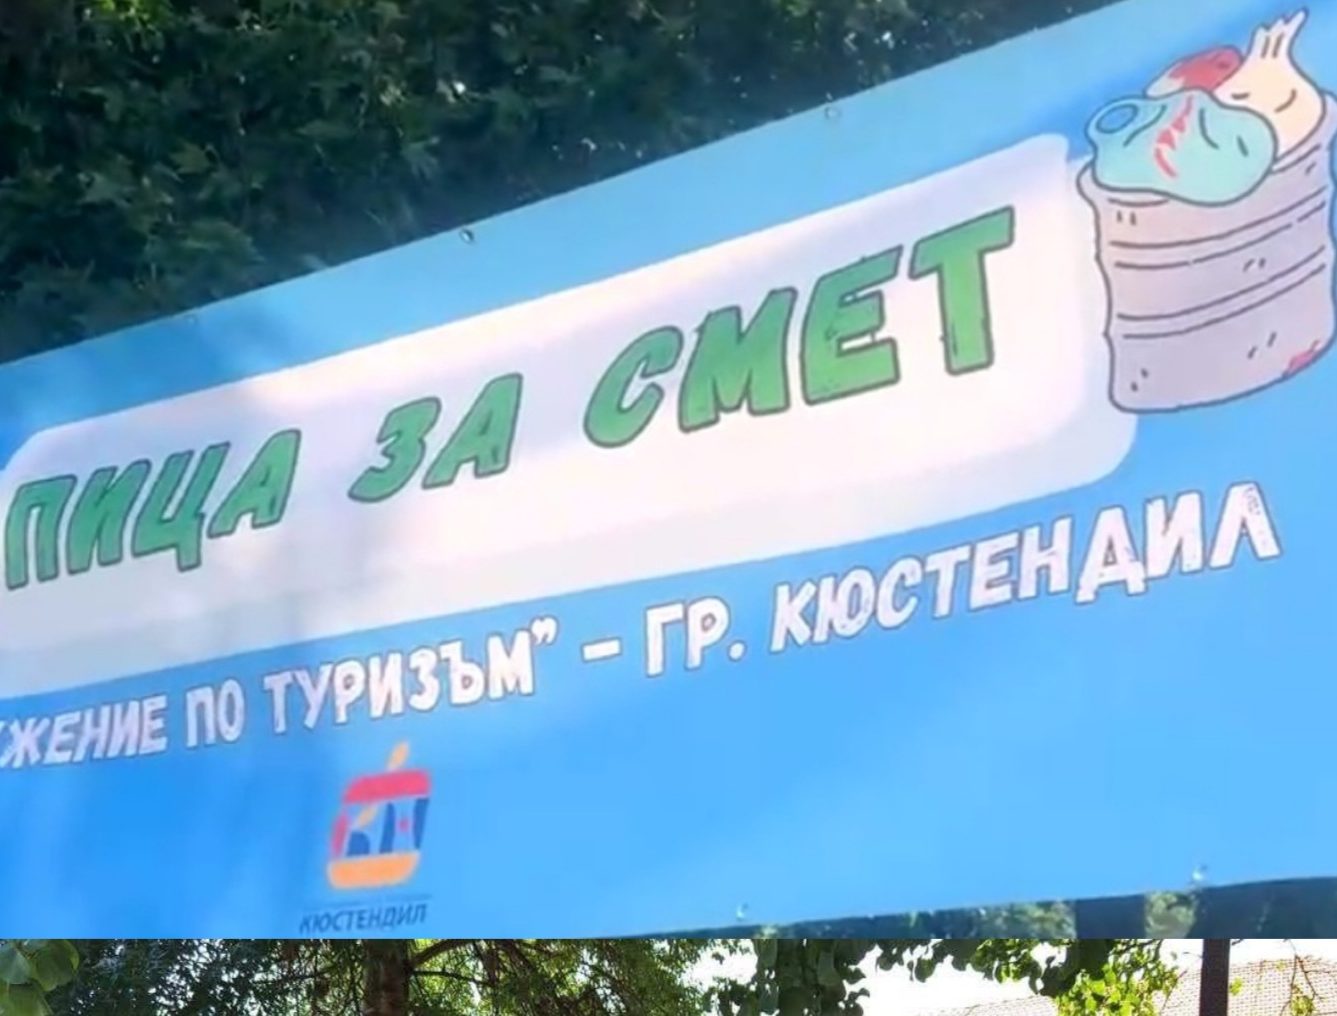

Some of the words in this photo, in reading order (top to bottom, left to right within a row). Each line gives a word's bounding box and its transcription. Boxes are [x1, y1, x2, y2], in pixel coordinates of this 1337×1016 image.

[3, 428, 302, 590] ПИЦА
[347, 371, 524, 503] ЗА
[583, 204, 1016, 449] СМЕТ
[186, 679, 246, 748] ПО
[645, 596, 745, 678] ГР.
[769, 481, 1283, 654] КЮСТЕНДИЛ
[299, 903, 428, 935] КЮСТЕНДИЛ
